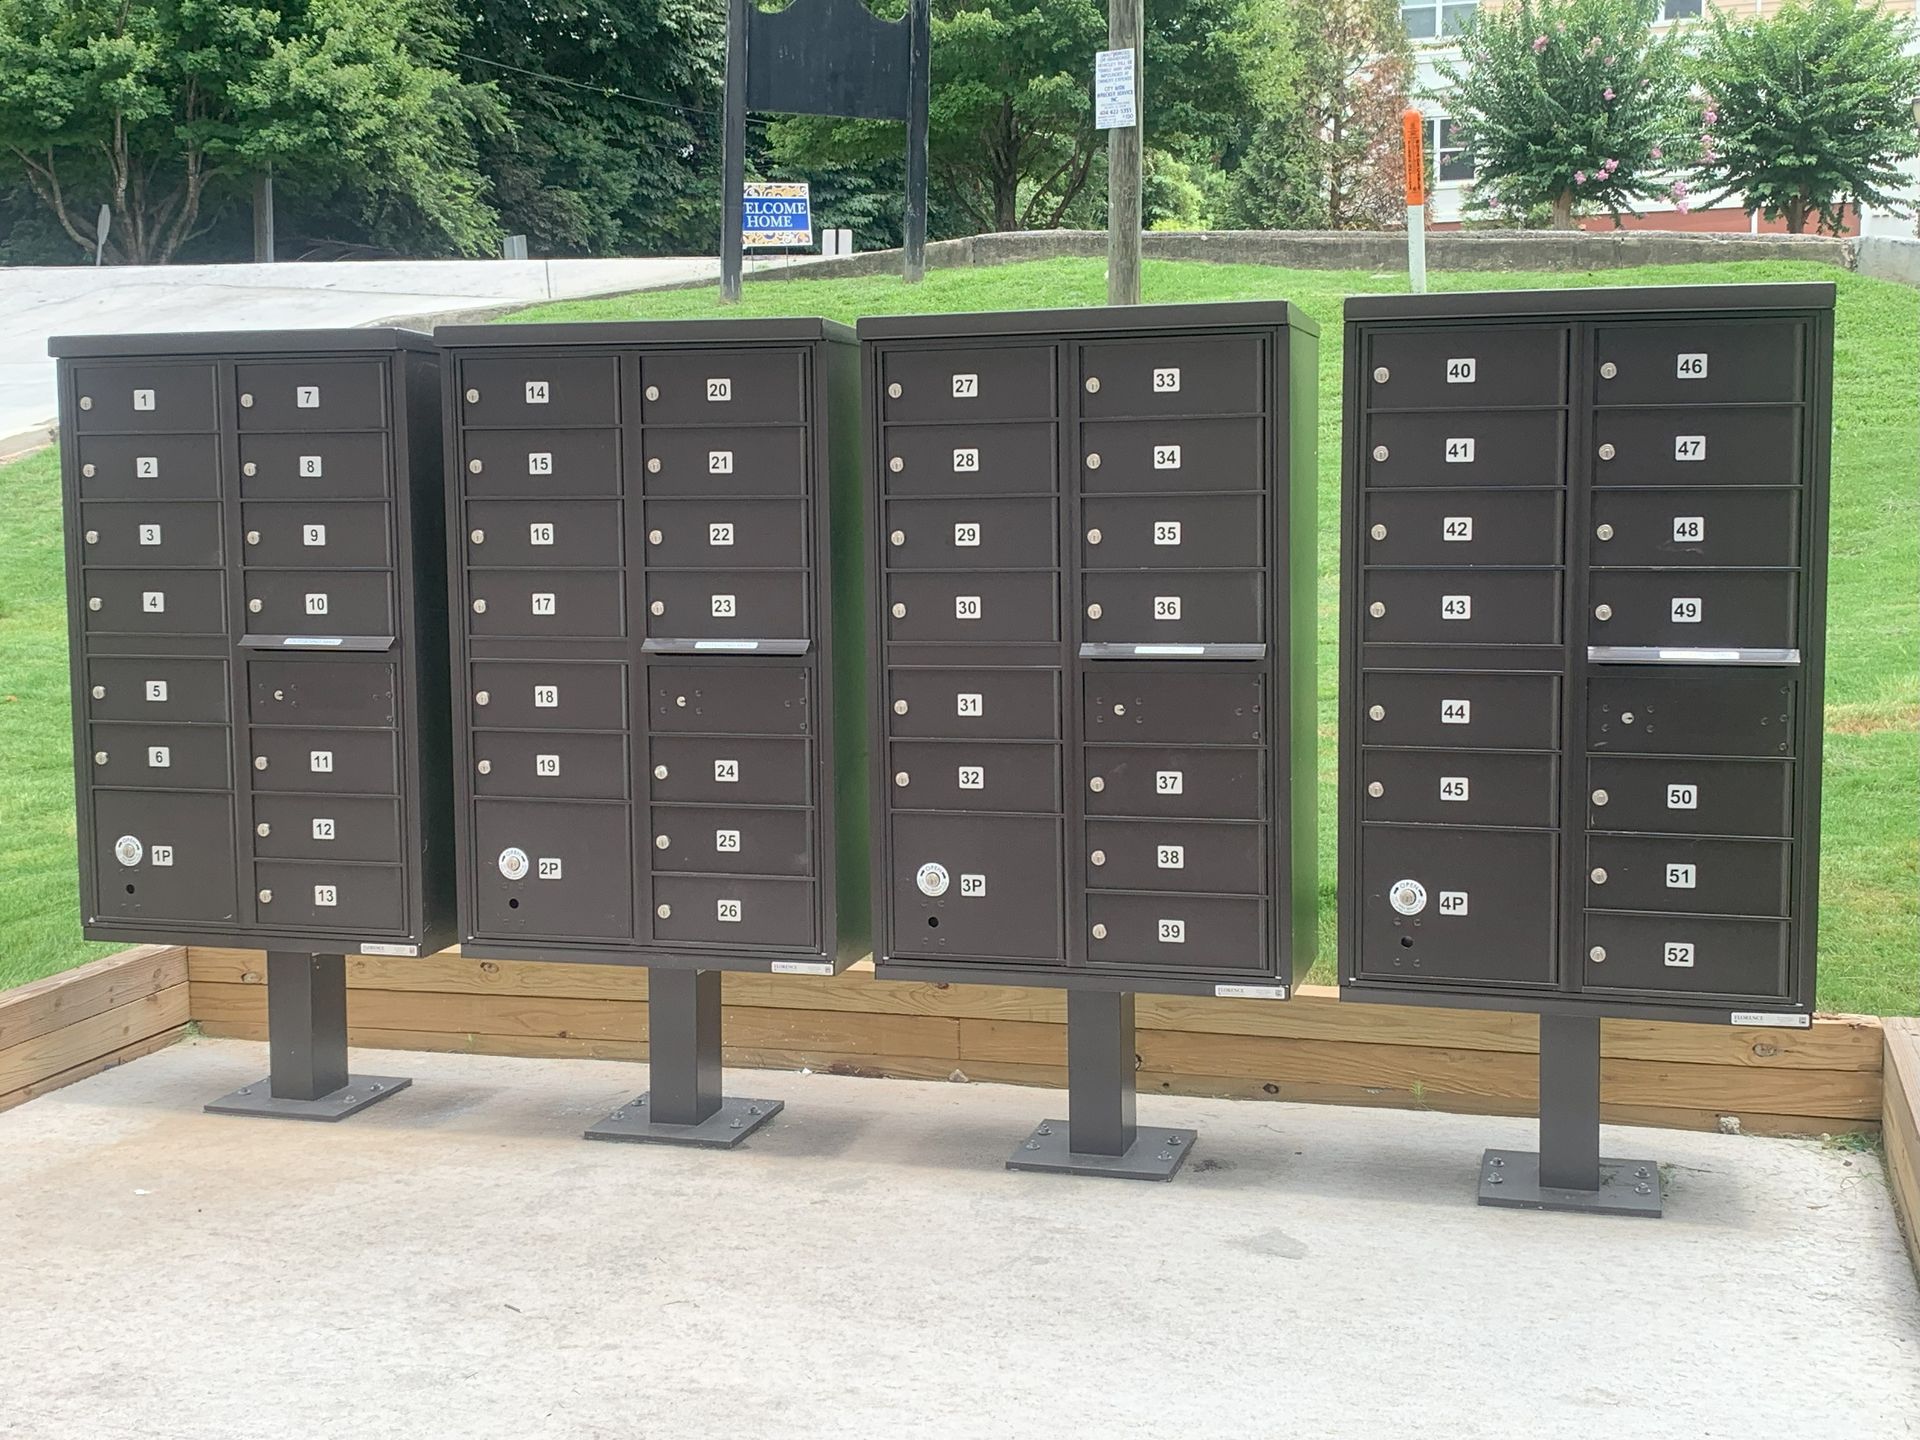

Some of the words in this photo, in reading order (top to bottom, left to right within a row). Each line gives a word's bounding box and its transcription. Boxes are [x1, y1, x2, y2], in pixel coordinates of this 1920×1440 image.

[744, 202, 807, 215] ELCOME
[747, 215, 793, 228] HOME
[1449, 363, 1471, 378] 40
[1679, 358, 1703, 374] 46
[955, 379, 974, 393] 27
[1156, 373, 1176, 388] 33
[528, 385, 545, 399] 14
[709, 383, 727, 397] 20
[141, 394, 147, 406] 1
[304, 391, 312, 404] 7
[1448, 443, 1468, 458] 41
[1677, 441, 1701, 456] 47
[531, 457, 549, 471] 15
[711, 456, 727, 469] 21
[956, 453, 975, 467] 28
[1157, 450, 1176, 465] 34
[143, 461, 152, 474] 2
[307, 460, 315, 473] 8
[146, 529, 154, 541] 3
[310, 529, 318, 542] 9
[533, 527, 550, 541] 16
[712, 527, 730, 541] 22
[957, 528, 976, 542] 29
[1157, 526, 1176, 541] 35
[1446, 521, 1468, 537] 42
[1676, 522, 1699, 537] 48
[149, 596, 158, 608] 4
[309, 597, 325, 611] 10
[535, 598, 551, 610] 17
[714, 599, 732, 613] 23
[958, 600, 977, 615] 30
[1157, 601, 1177, 616] 36
[1444, 600, 1466, 615] 43
[1673, 602, 1697, 618] 49
[153, 685, 161, 698] 5
[537, 690, 554, 703] 18
[960, 698, 976, 712] 31
[1443, 704, 1465, 719] 44
[155, 750, 163, 764] 6
[314, 755, 328, 768] 11
[540, 759, 556, 773] 19
[717, 764, 735, 778] 24
[961, 771, 979, 785] 32
[1159, 775, 1178, 790] 37
[1442, 782, 1464, 797] 45
[1670, 789, 1692, 805] 50
[316, 823, 332, 836] 12
[719, 834, 737, 848] 25
[154, 850, 171, 862] 1P
[1160, 850, 1179, 864] 38
[540, 862, 559, 875] 2P
[1669, 868, 1689, 884] 51
[962, 878, 983, 892] 3P
[318, 889, 334, 903] 13
[1441, 896, 1464, 911] 4P
[720, 904, 738, 918] 26
[1161, 924, 1180, 939] 39
[1667, 947, 1689, 963] 52
